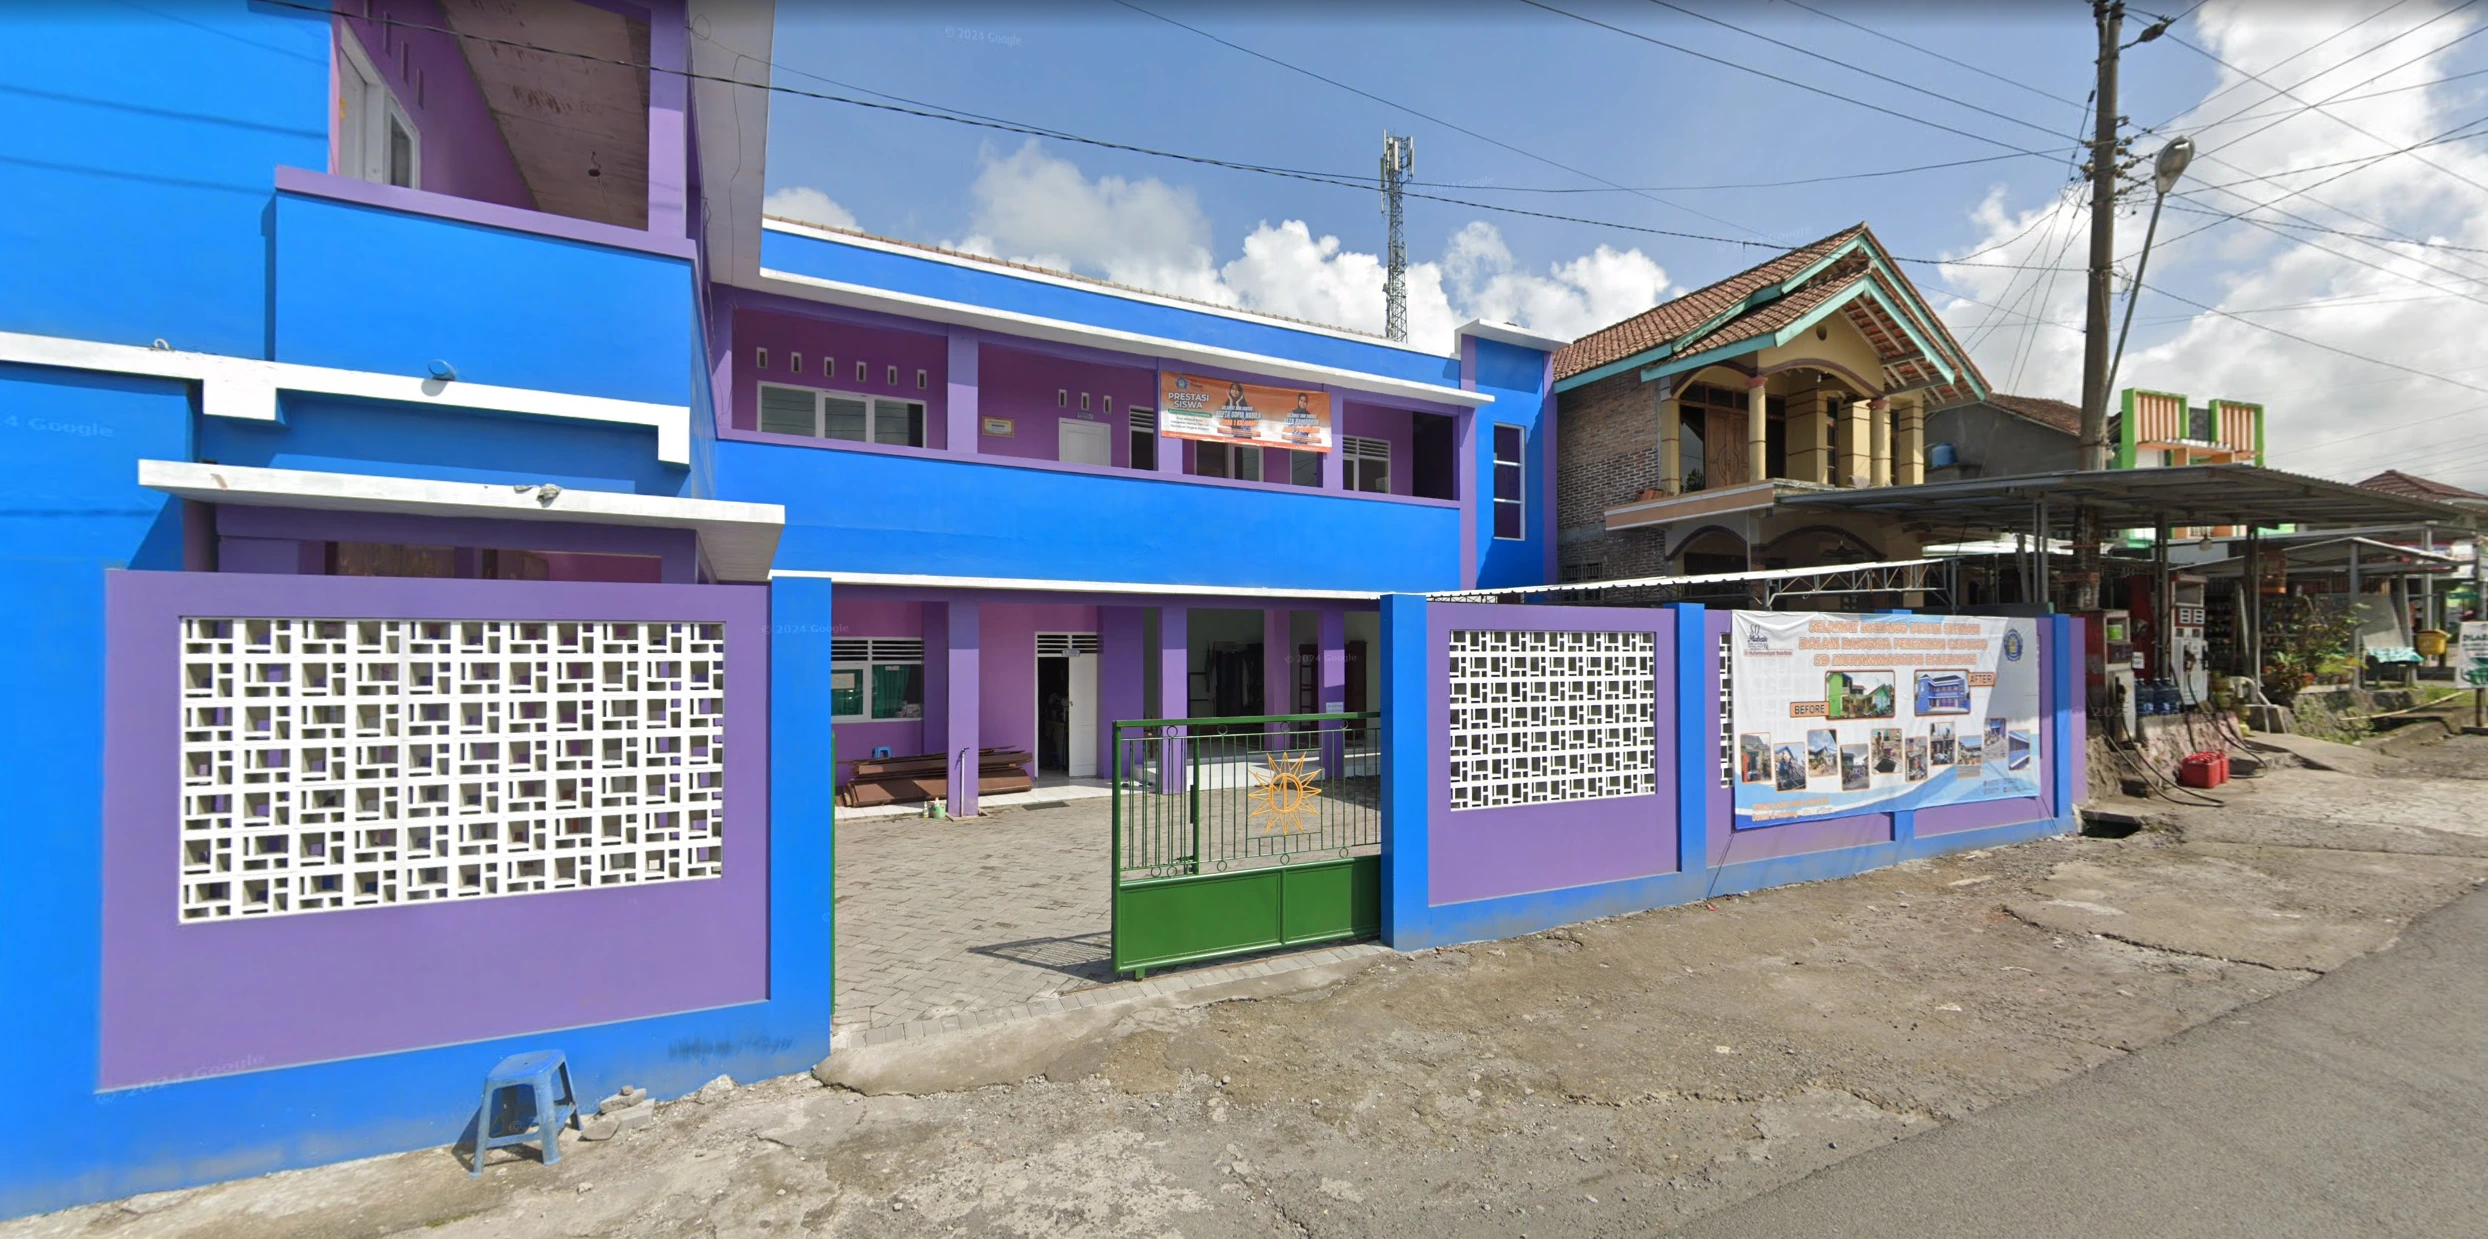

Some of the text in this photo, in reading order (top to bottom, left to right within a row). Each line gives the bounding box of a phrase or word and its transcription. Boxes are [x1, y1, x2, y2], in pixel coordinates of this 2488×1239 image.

[1168, 392, 1210, 402] PRESTASI
[1174, 400, 1203, 409] SISWA
[1808, 620, 1859, 633] SELAMAT
[1860, 622, 1908, 634] DATANG
[1798, 636, 1840, 650] DALAM
[1841, 637, 1893, 650] RANGKA
[1893, 638, 1946, 650] PERESMIAN
[1813, 653, 1831, 666] SD
[1831, 653, 1925, 667] MUHAMMADIYAH
[1969, 674, 1993, 684] AFTER
[1794, 704, 1825, 715] BEFORE
